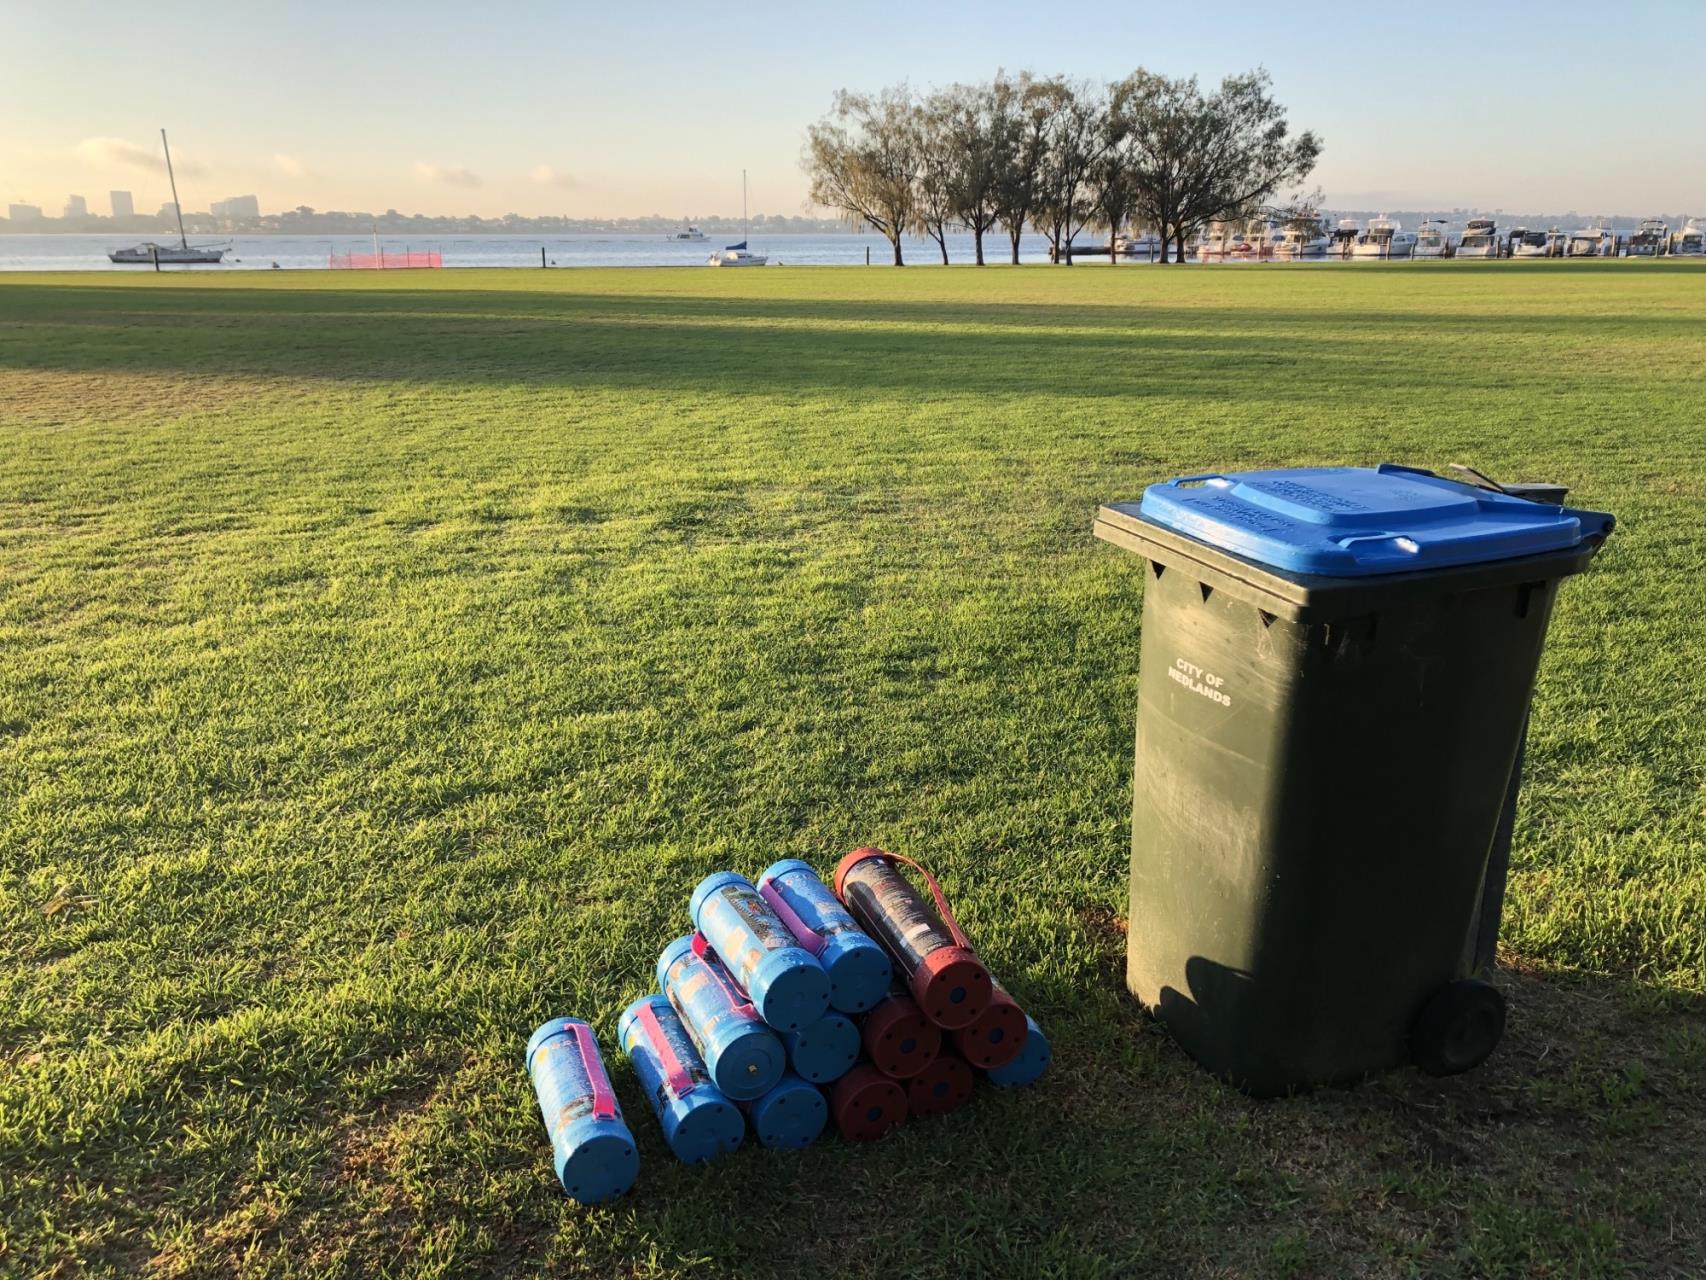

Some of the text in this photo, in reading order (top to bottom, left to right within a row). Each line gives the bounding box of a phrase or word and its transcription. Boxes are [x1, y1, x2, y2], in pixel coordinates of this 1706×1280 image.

[1168, 666, 1231, 707] NEDLANDS
[1176, 658, 1224, 688] CITY OF
